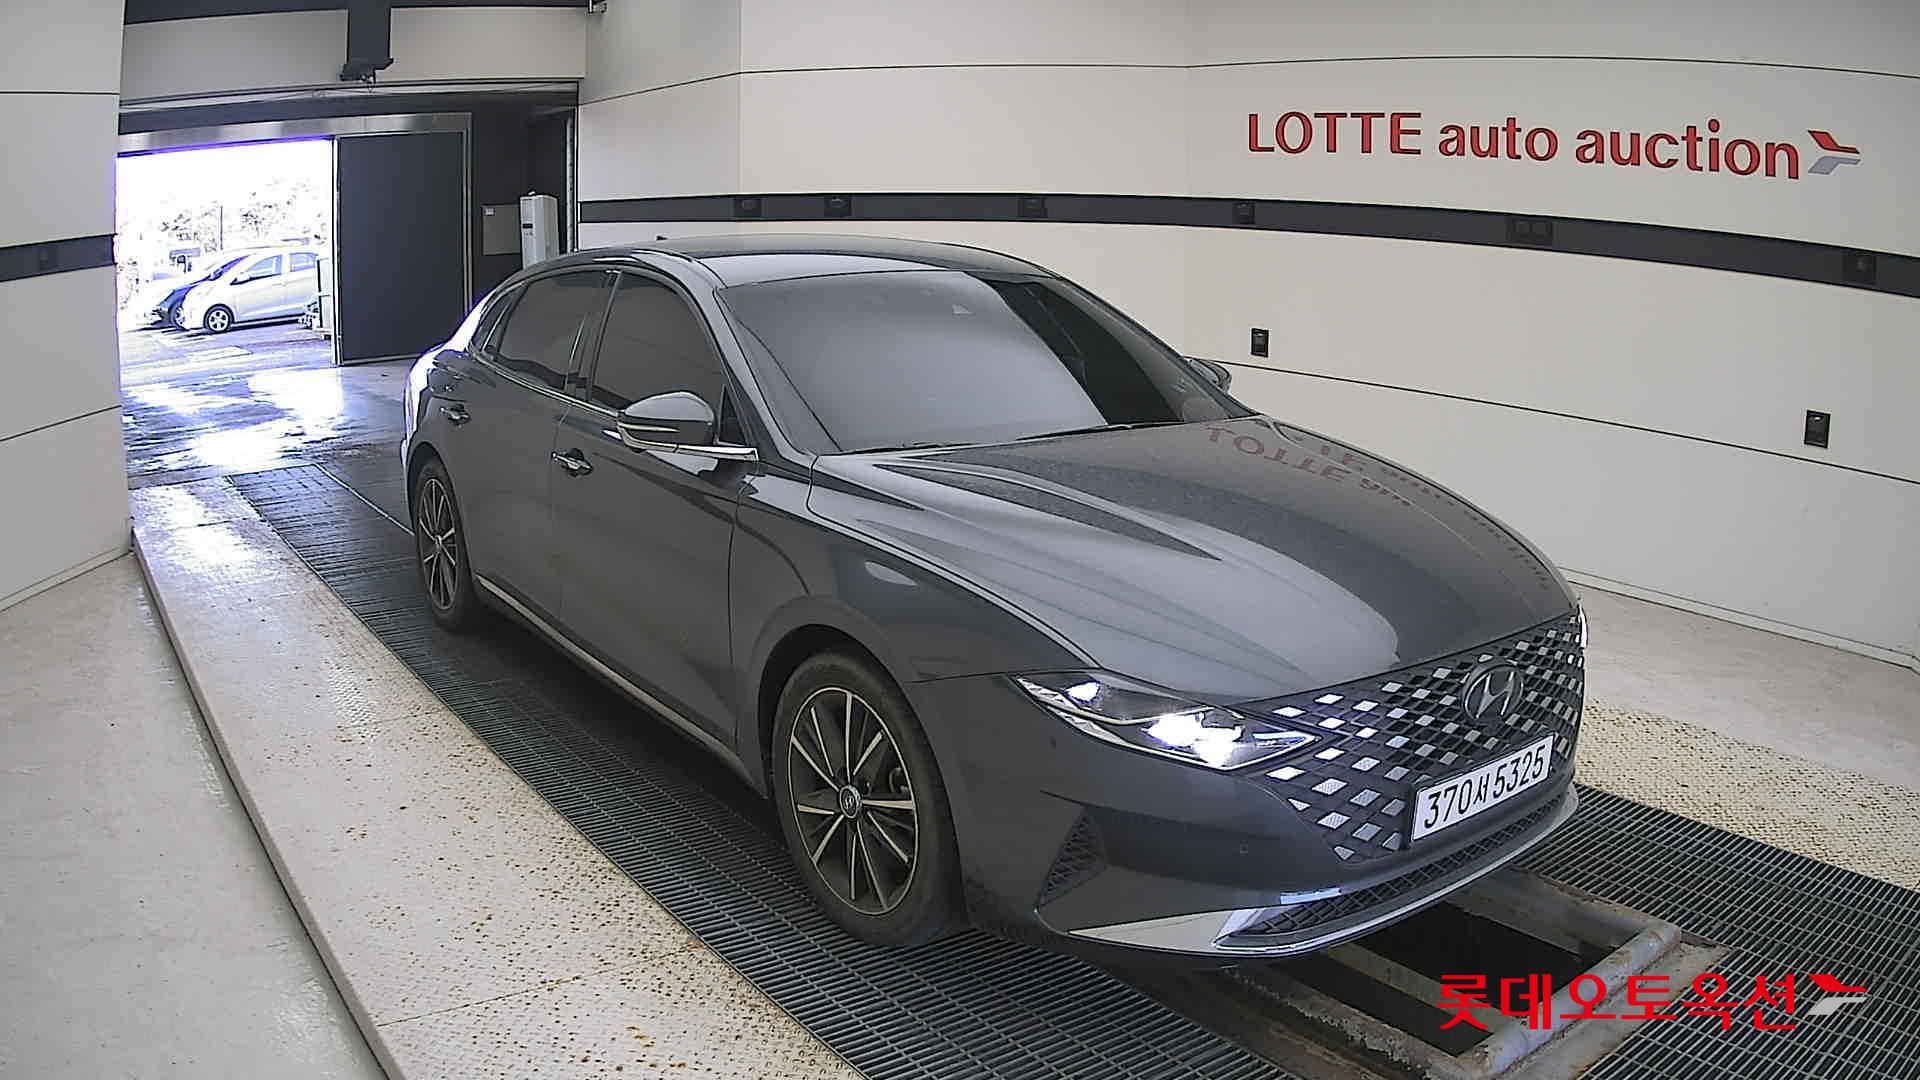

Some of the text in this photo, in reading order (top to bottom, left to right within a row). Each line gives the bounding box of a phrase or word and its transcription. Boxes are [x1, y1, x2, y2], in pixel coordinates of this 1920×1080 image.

[1247, 111, 1800, 180] LOTTE auto auction
